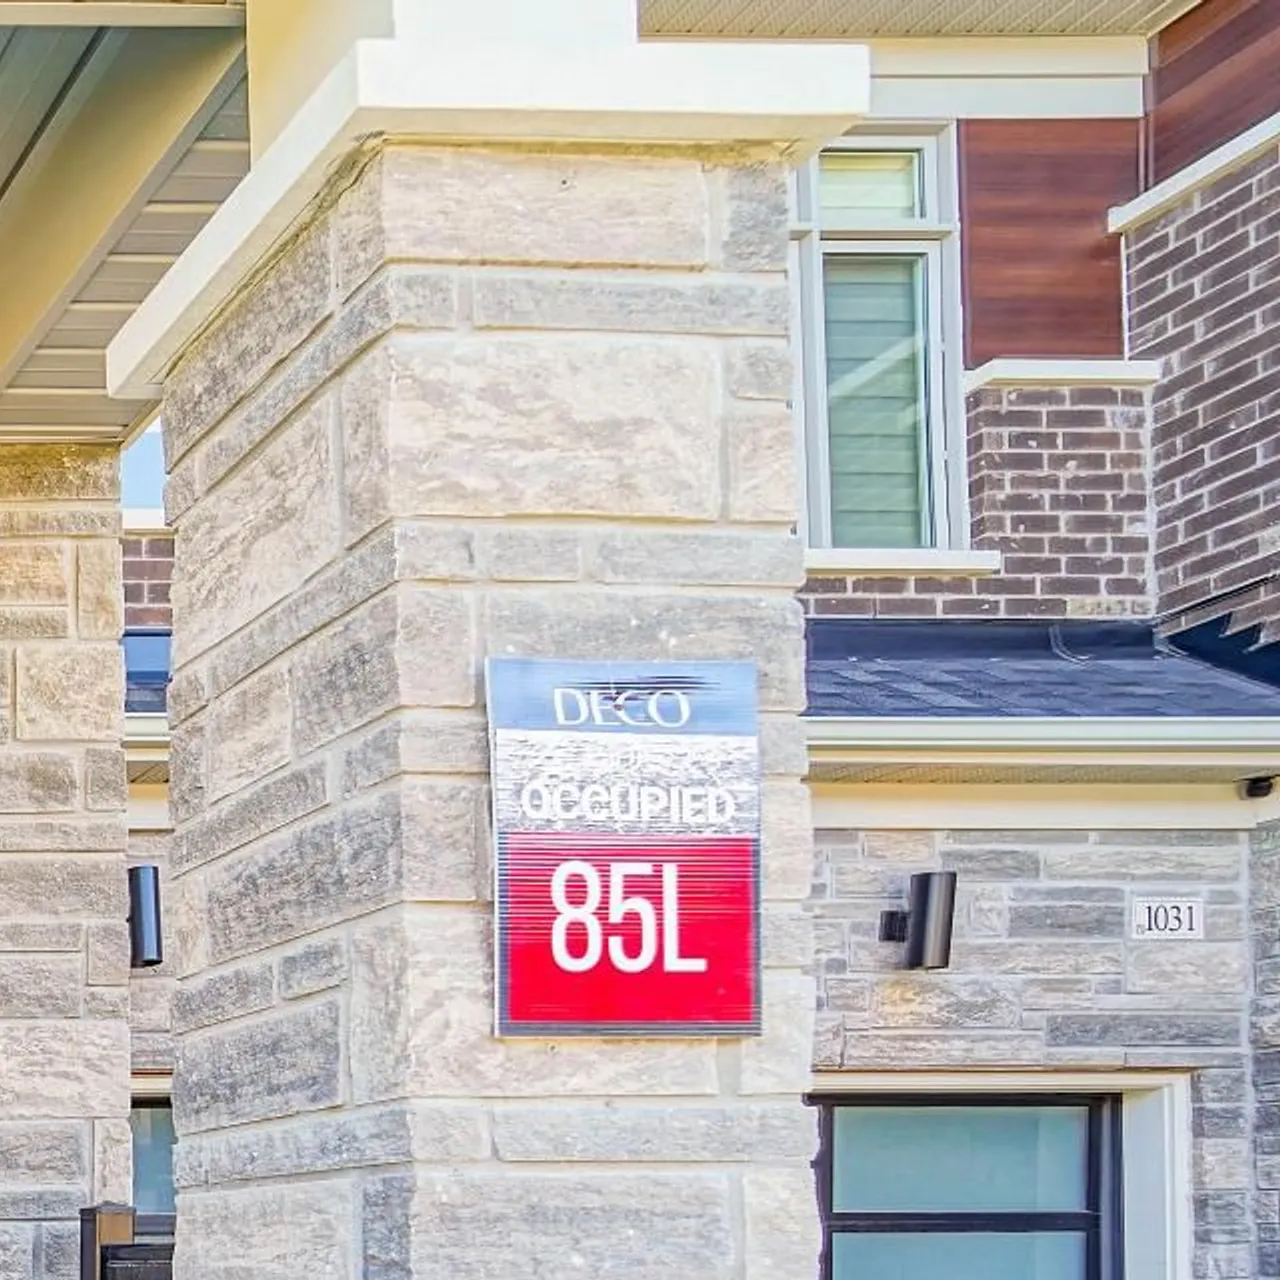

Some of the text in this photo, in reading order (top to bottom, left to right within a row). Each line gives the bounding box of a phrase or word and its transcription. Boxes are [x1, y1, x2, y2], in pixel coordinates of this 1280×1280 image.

[553, 688, 691, 728] DECO
[520, 781, 737, 824] OCCUPIED
[550, 860, 708, 974] 85L
[1146, 905, 1196, 932] 1031
